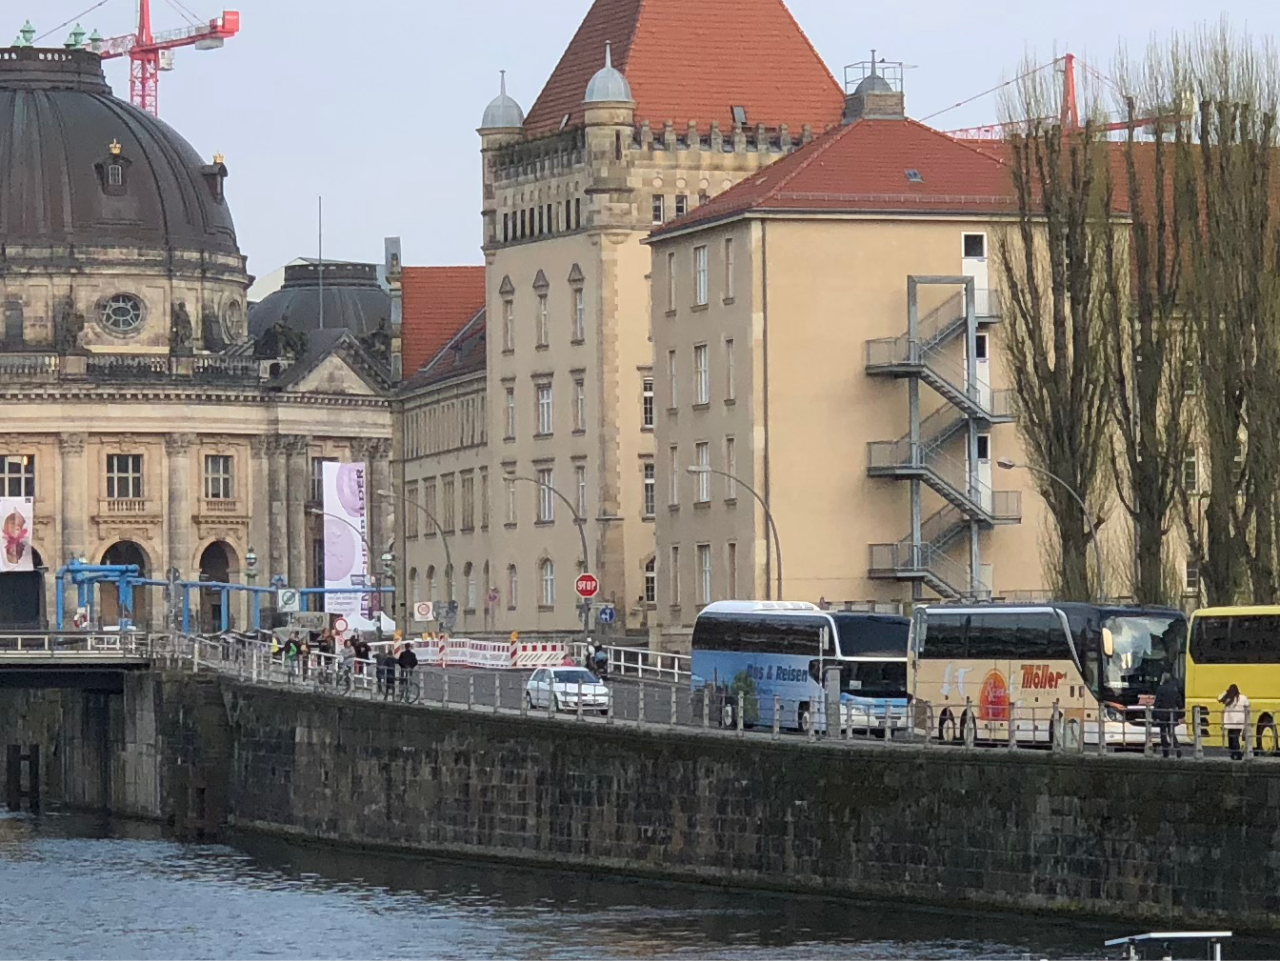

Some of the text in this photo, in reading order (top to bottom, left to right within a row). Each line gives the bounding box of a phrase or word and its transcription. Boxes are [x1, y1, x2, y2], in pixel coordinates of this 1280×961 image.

[577, 580, 596, 591] STOP
[747, 663, 808, 683] Bus & Reisen
[1021, 664, 1066, 689] Möller
